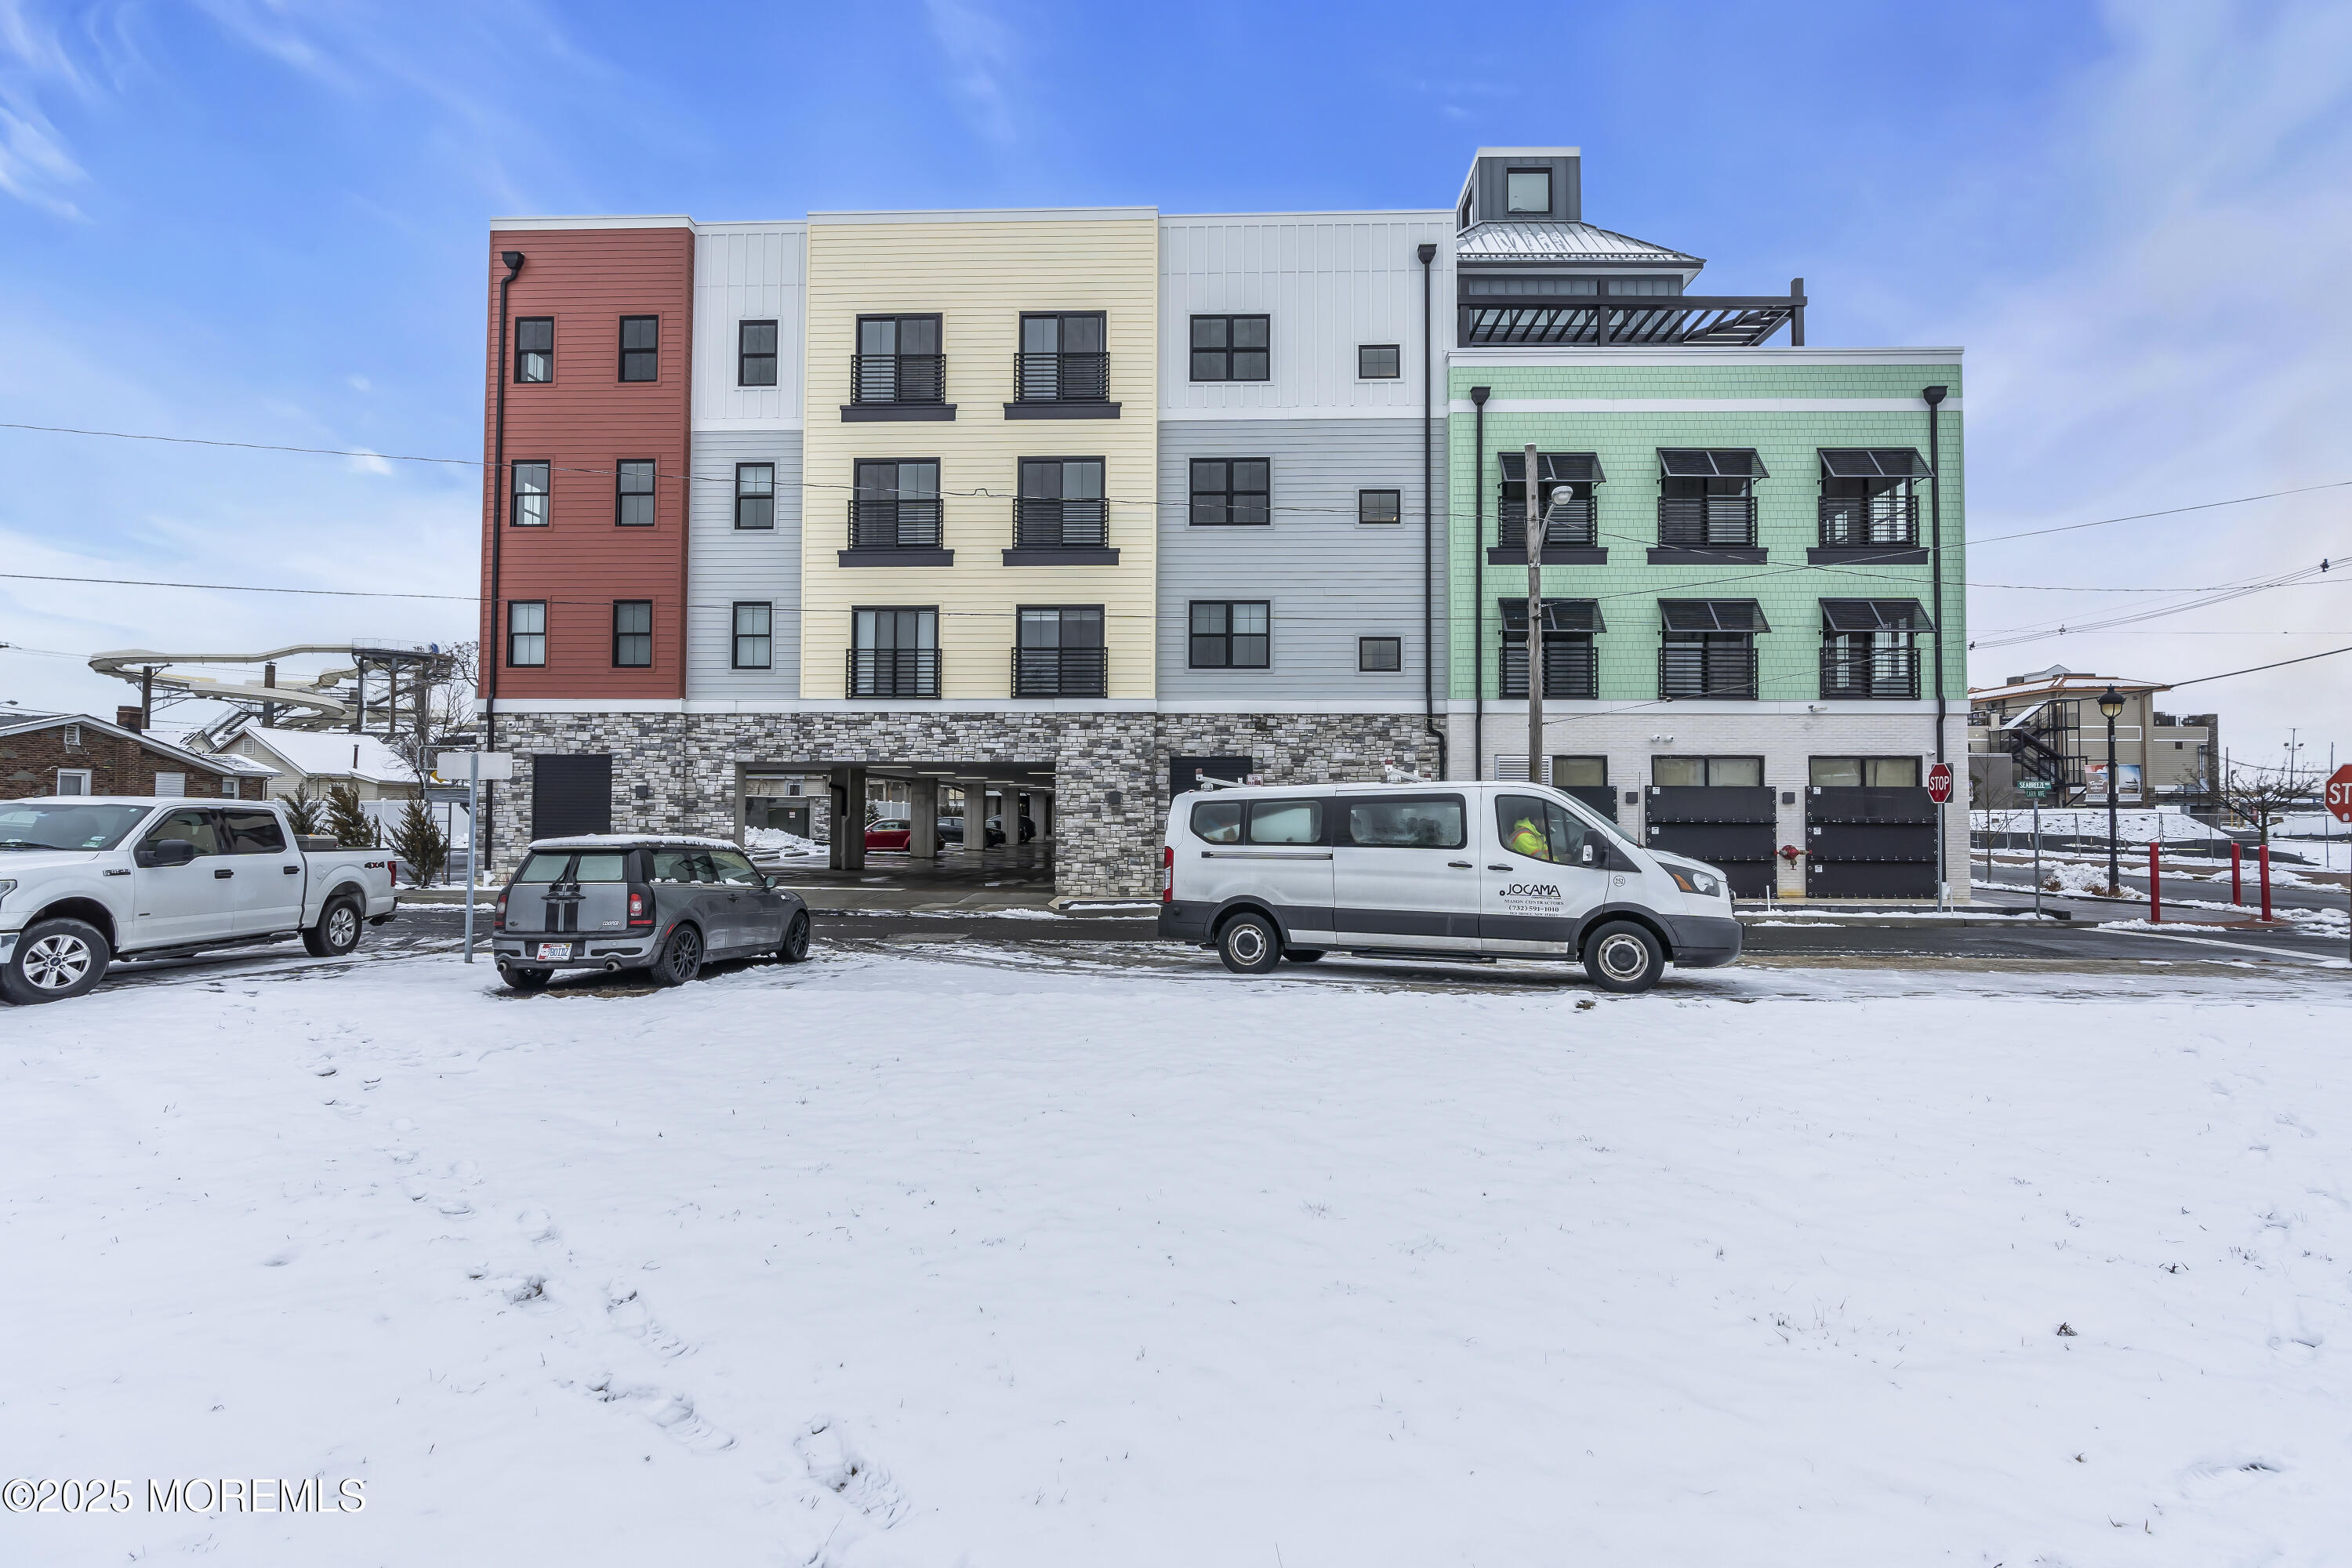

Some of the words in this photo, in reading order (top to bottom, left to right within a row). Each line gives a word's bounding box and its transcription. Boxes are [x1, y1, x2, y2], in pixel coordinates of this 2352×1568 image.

[1929, 776, 1950, 791] STOP
[2328, 782, 2352, 804] ST
[1507, 884, 1561, 898] JOCAMA
